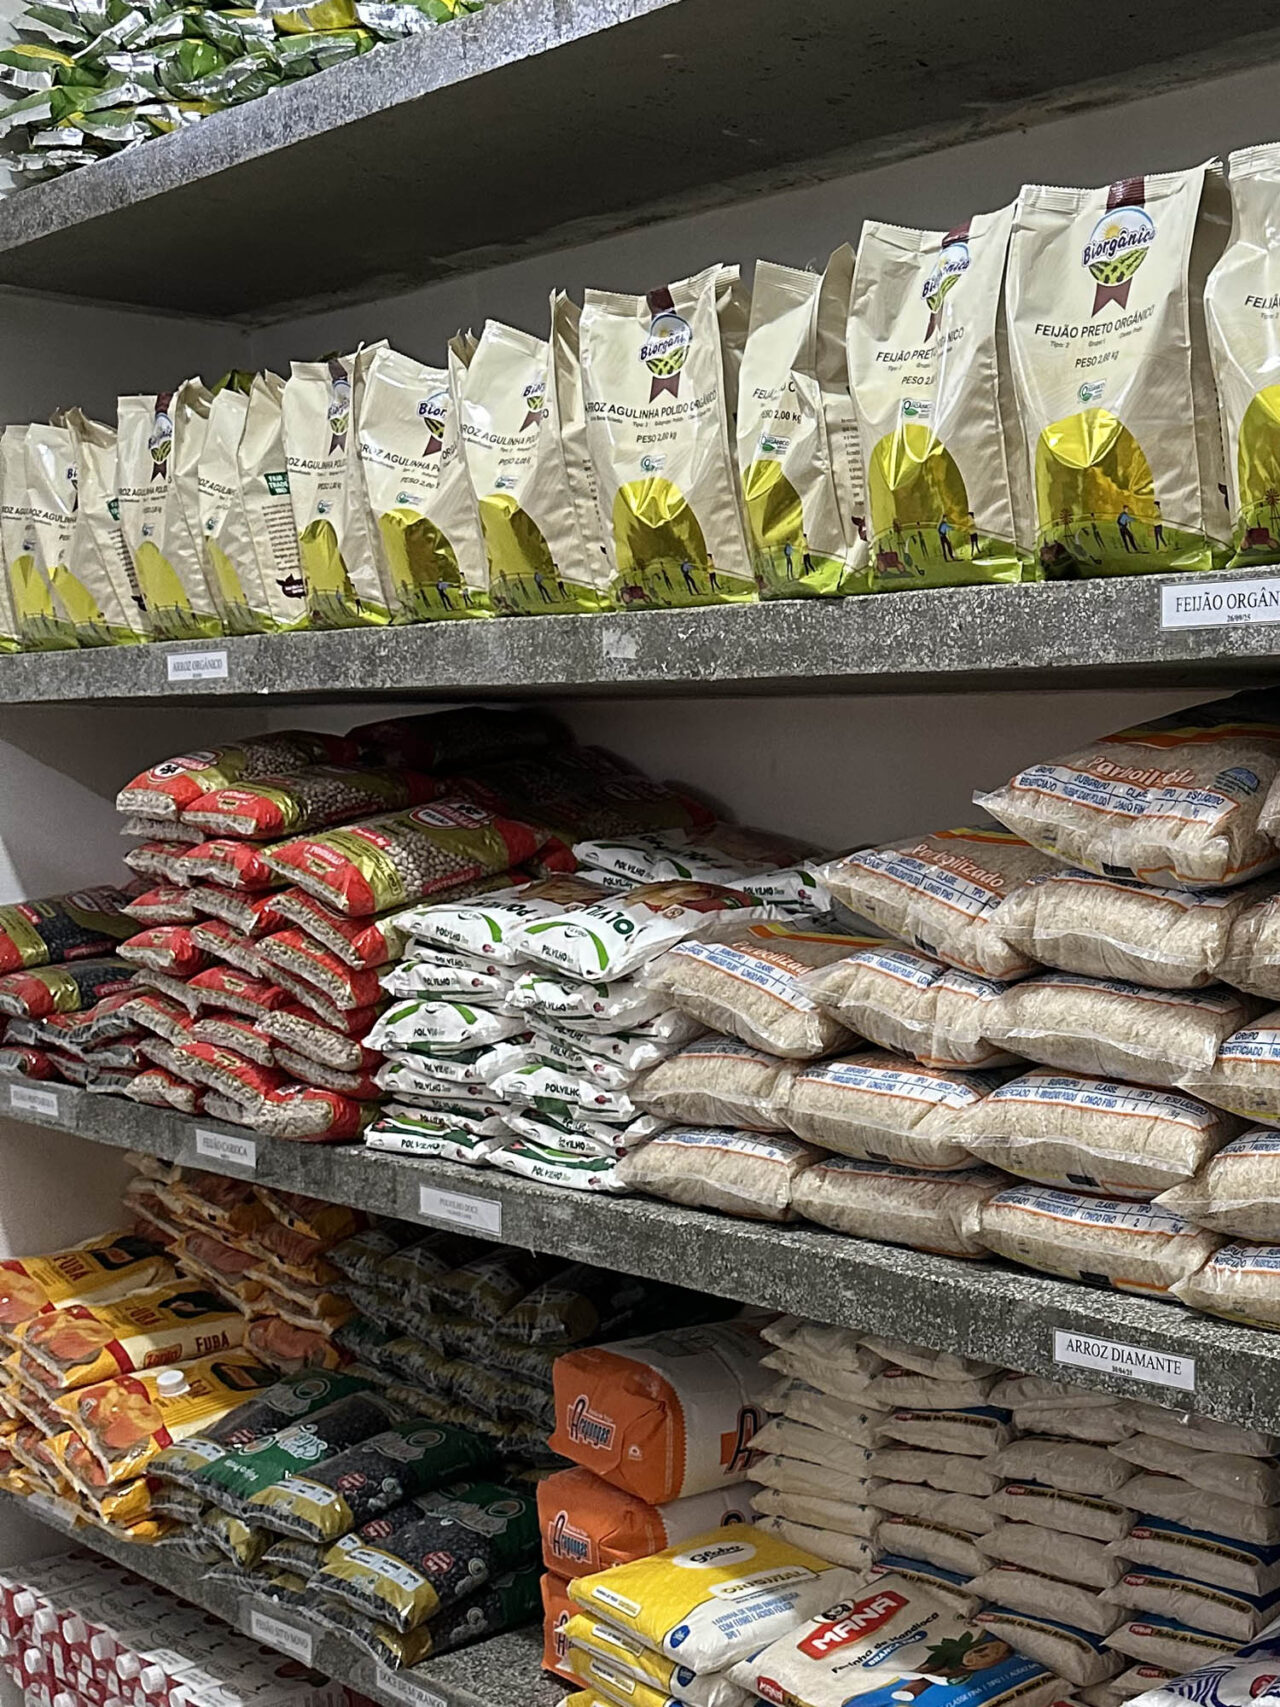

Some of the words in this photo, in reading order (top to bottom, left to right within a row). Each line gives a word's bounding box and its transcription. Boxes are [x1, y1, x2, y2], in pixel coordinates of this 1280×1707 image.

[1035, 323, 1078, 338] FEIJÃO
[1081, 322, 1112, 338] PRETO
[876, 351, 910, 362] FEIJÃO
[1075, 354, 1097, 368] PESO
[902, 376, 923, 384] PESO
[608, 403, 660, 418] AGULINHA
[661, 403, 688, 417] POLIDO
[383, 453, 430, 471] AGULINHA
[1176, 592, 1223, 612] FEIJÃO
[195, 1331, 230, 1354] FUBÁ
[1066, 1338, 1108, 1360] ARROZ
[1111, 1347, 1182, 1376] DIAMANTE
[811, 1595, 898, 1650] MANÁ
[889, 1612, 939, 1642] Mandioca
